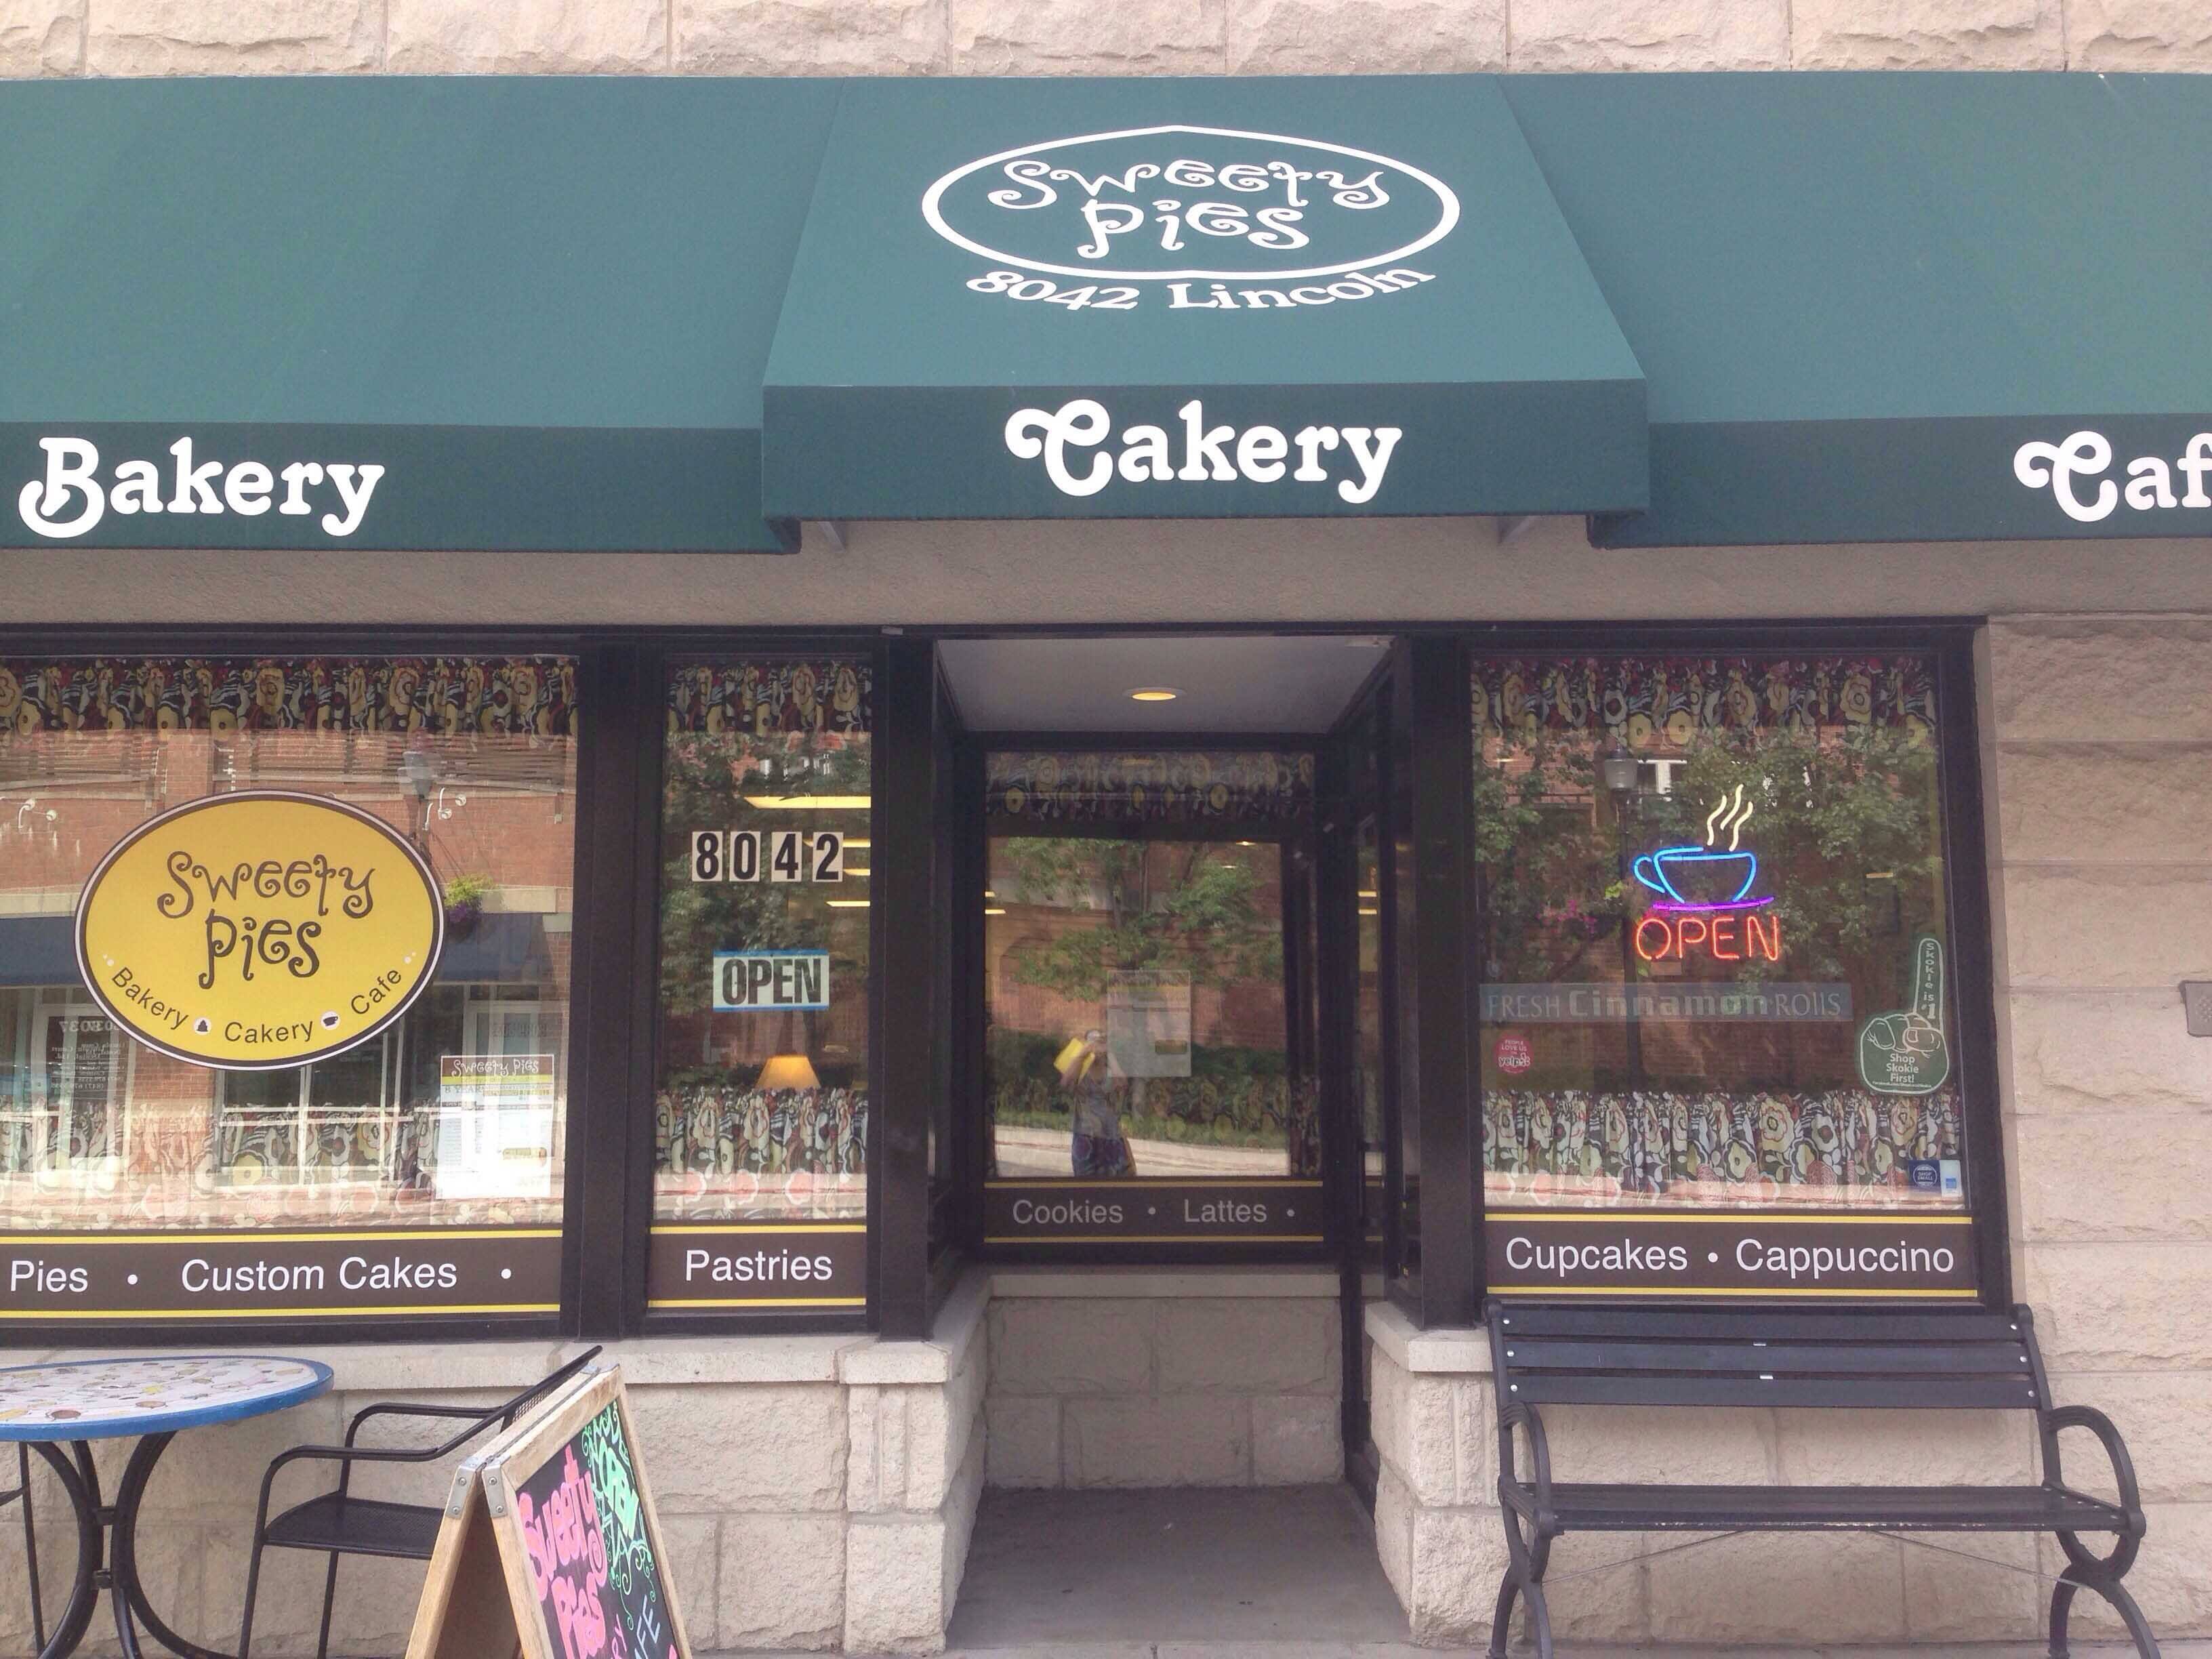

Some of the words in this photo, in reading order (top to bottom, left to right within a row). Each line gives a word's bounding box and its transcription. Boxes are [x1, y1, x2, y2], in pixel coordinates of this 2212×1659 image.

[966, 271, 1139, 311] 8042
[1167, 268, 1437, 310] Lincoln
[1004, 398, 1403, 504] Cakery
[18, 436, 386, 538] Bakery
[695, 832, 840, 880] 8042
[1634, 914, 1781, 962] OPEN
[722, 958, 822, 1006] OPEN
[1923, 991, 1934, 1002] is
[111, 966, 189, 1030] Bakery
[224, 1021, 314, 1044] Cakery
[350, 969, 402, 1015] Cafe
[1490, 995, 1559, 1017] FRESH
[1568, 989, 1770, 1017] Cinnamon
[1886, 1063, 1919, 1073] Skokie
[1889, 1053, 1915, 1065] Shop
[1890, 1073, 1914, 1084] First!
[1012, 1199, 1124, 1224] Cookies
[1184, 1199, 1267, 1223] Lattes
[10, 1260, 89, 1292] Pies
[181, 1258, 325, 1292] Custom
[339, 1256, 458, 1290] Cakes
[684, 1249, 834, 1282] Pastries
[1506, 1237, 1687, 1278] Cupcakes
[1736, 1239, 1954, 1279] Cappuccino
